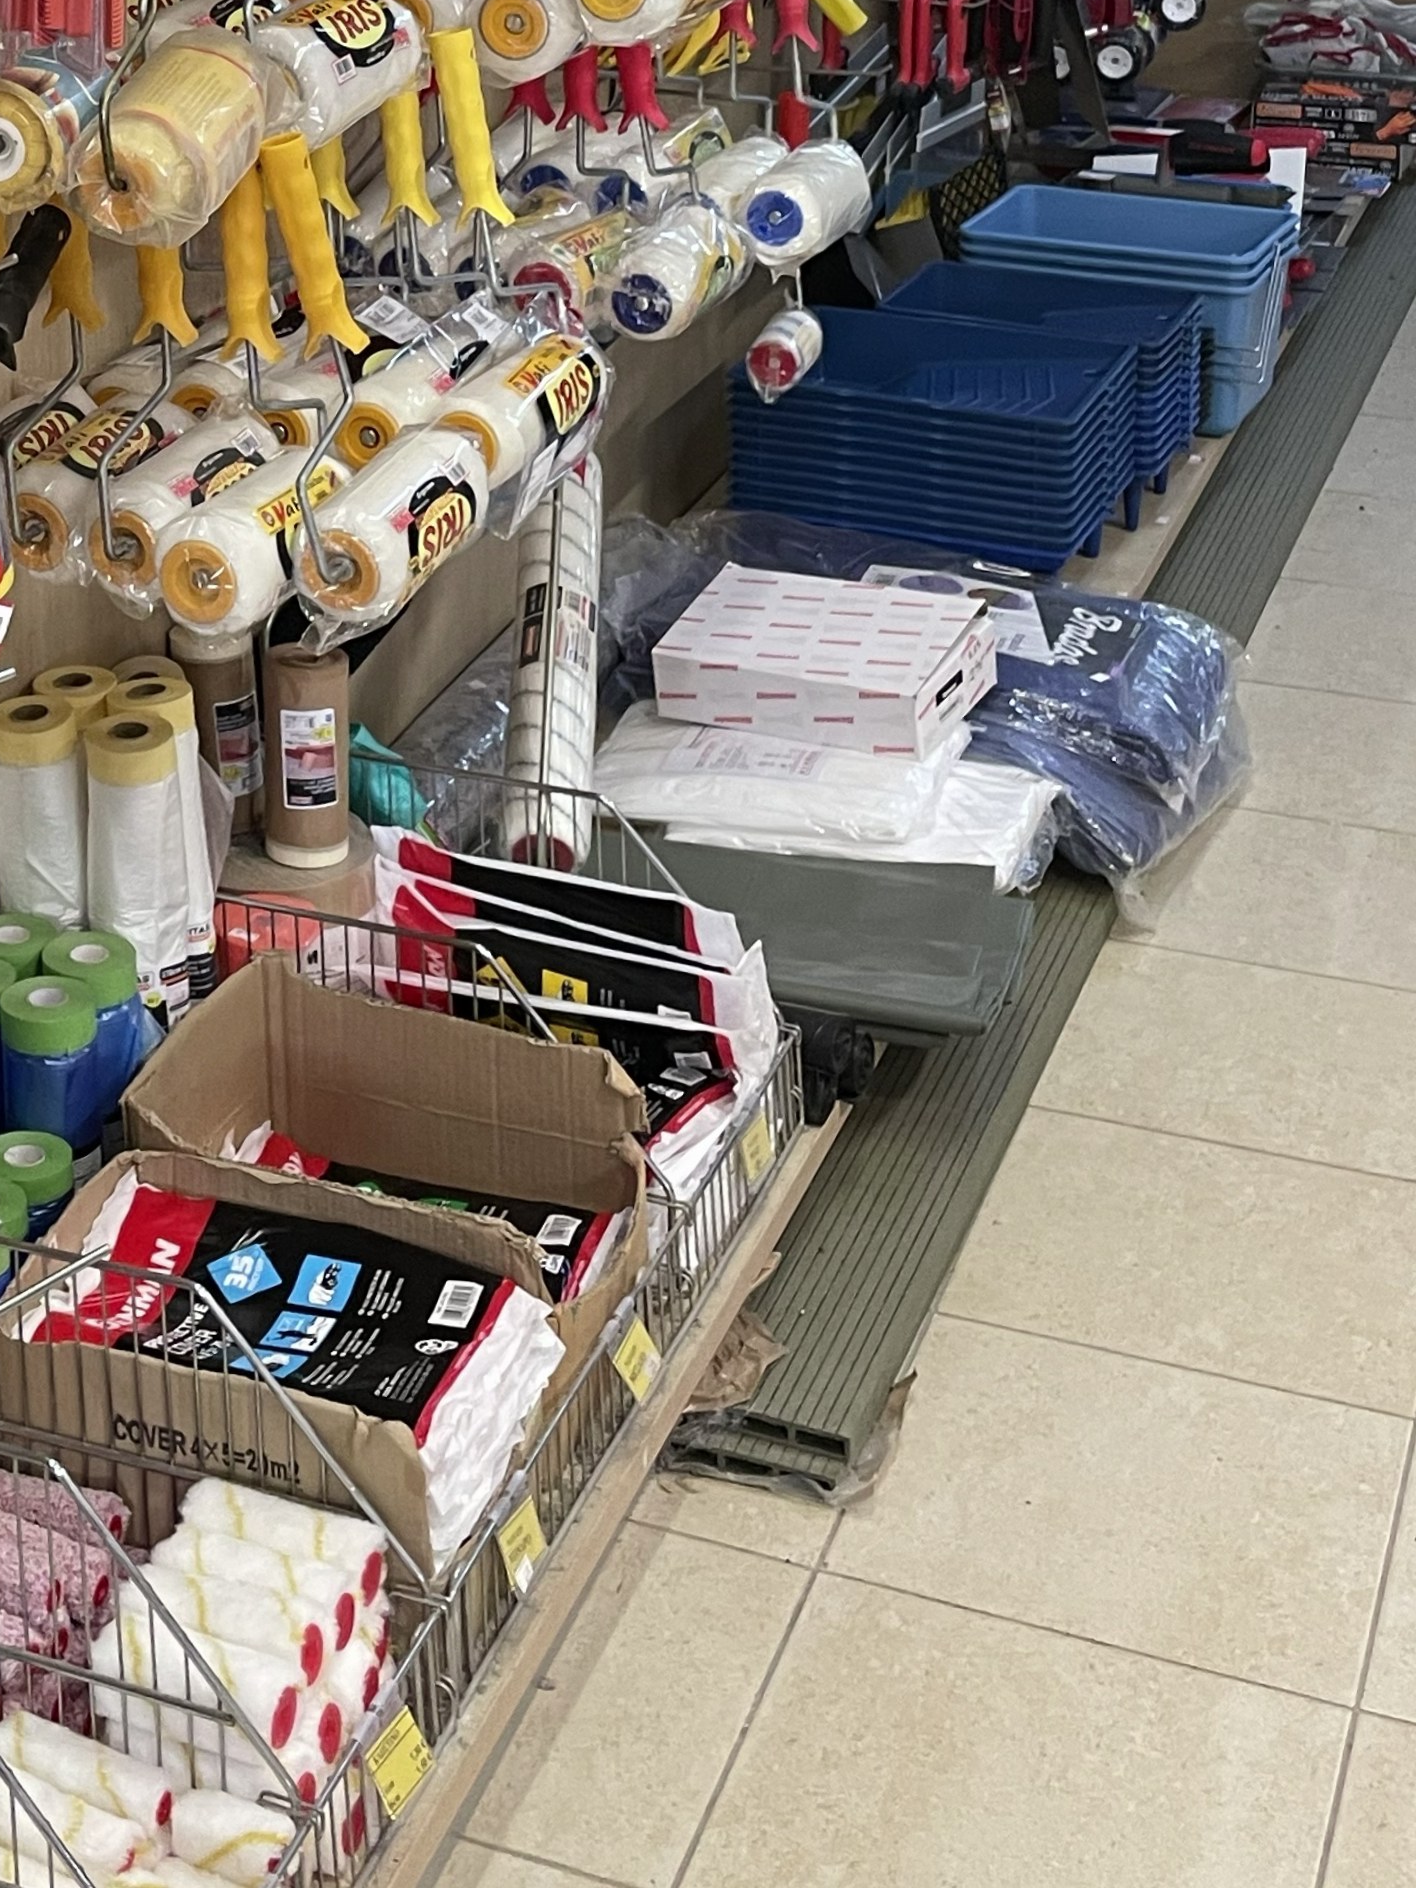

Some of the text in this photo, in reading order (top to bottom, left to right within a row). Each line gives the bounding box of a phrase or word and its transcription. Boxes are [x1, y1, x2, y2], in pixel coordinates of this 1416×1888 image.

[553, 364, 590, 428] IRIS
[422, 498, 464, 564] IRIS
[223, 1254, 256, 1291] 35
[114, 1413, 187, 1457] COVER
